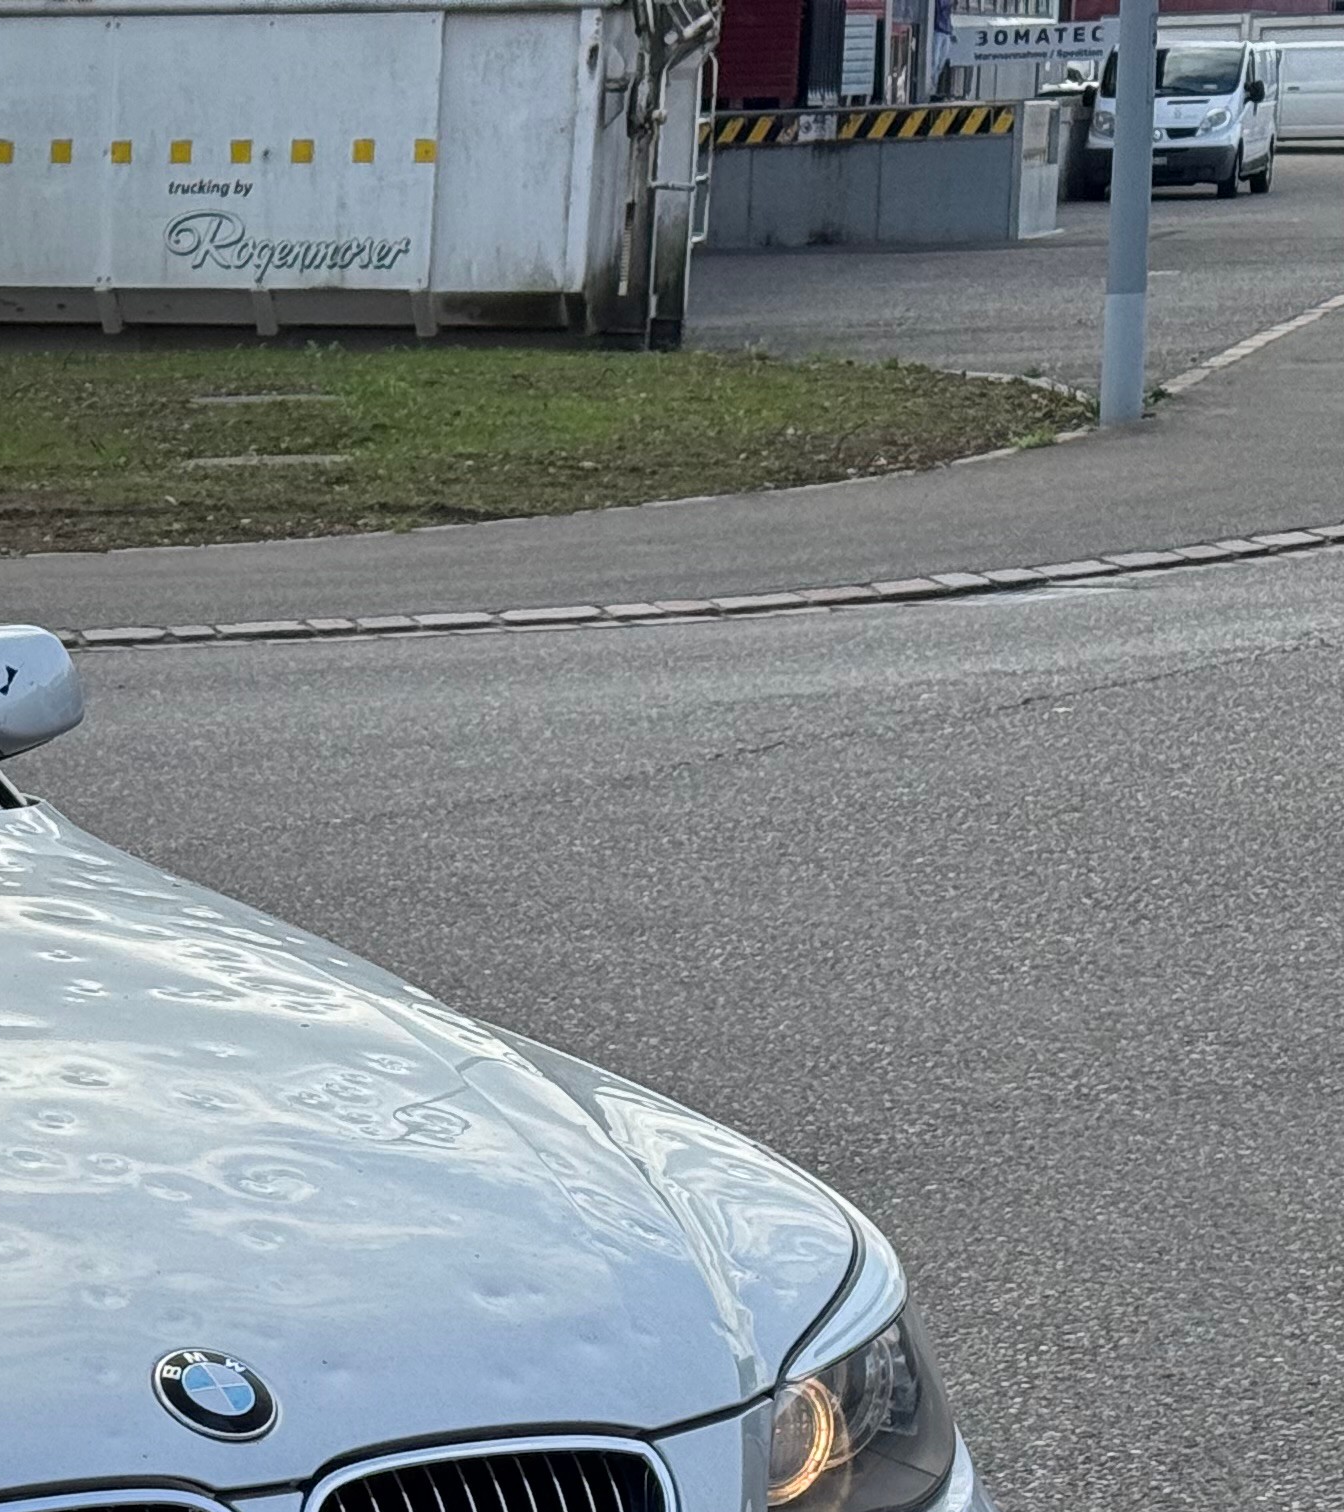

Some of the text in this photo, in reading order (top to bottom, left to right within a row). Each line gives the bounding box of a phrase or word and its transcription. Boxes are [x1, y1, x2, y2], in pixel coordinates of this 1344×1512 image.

[168, 179, 254, 198] trucking by
[164, 208, 412, 283] Rogenmoser
[162, 1351, 247, 1381] BMW
